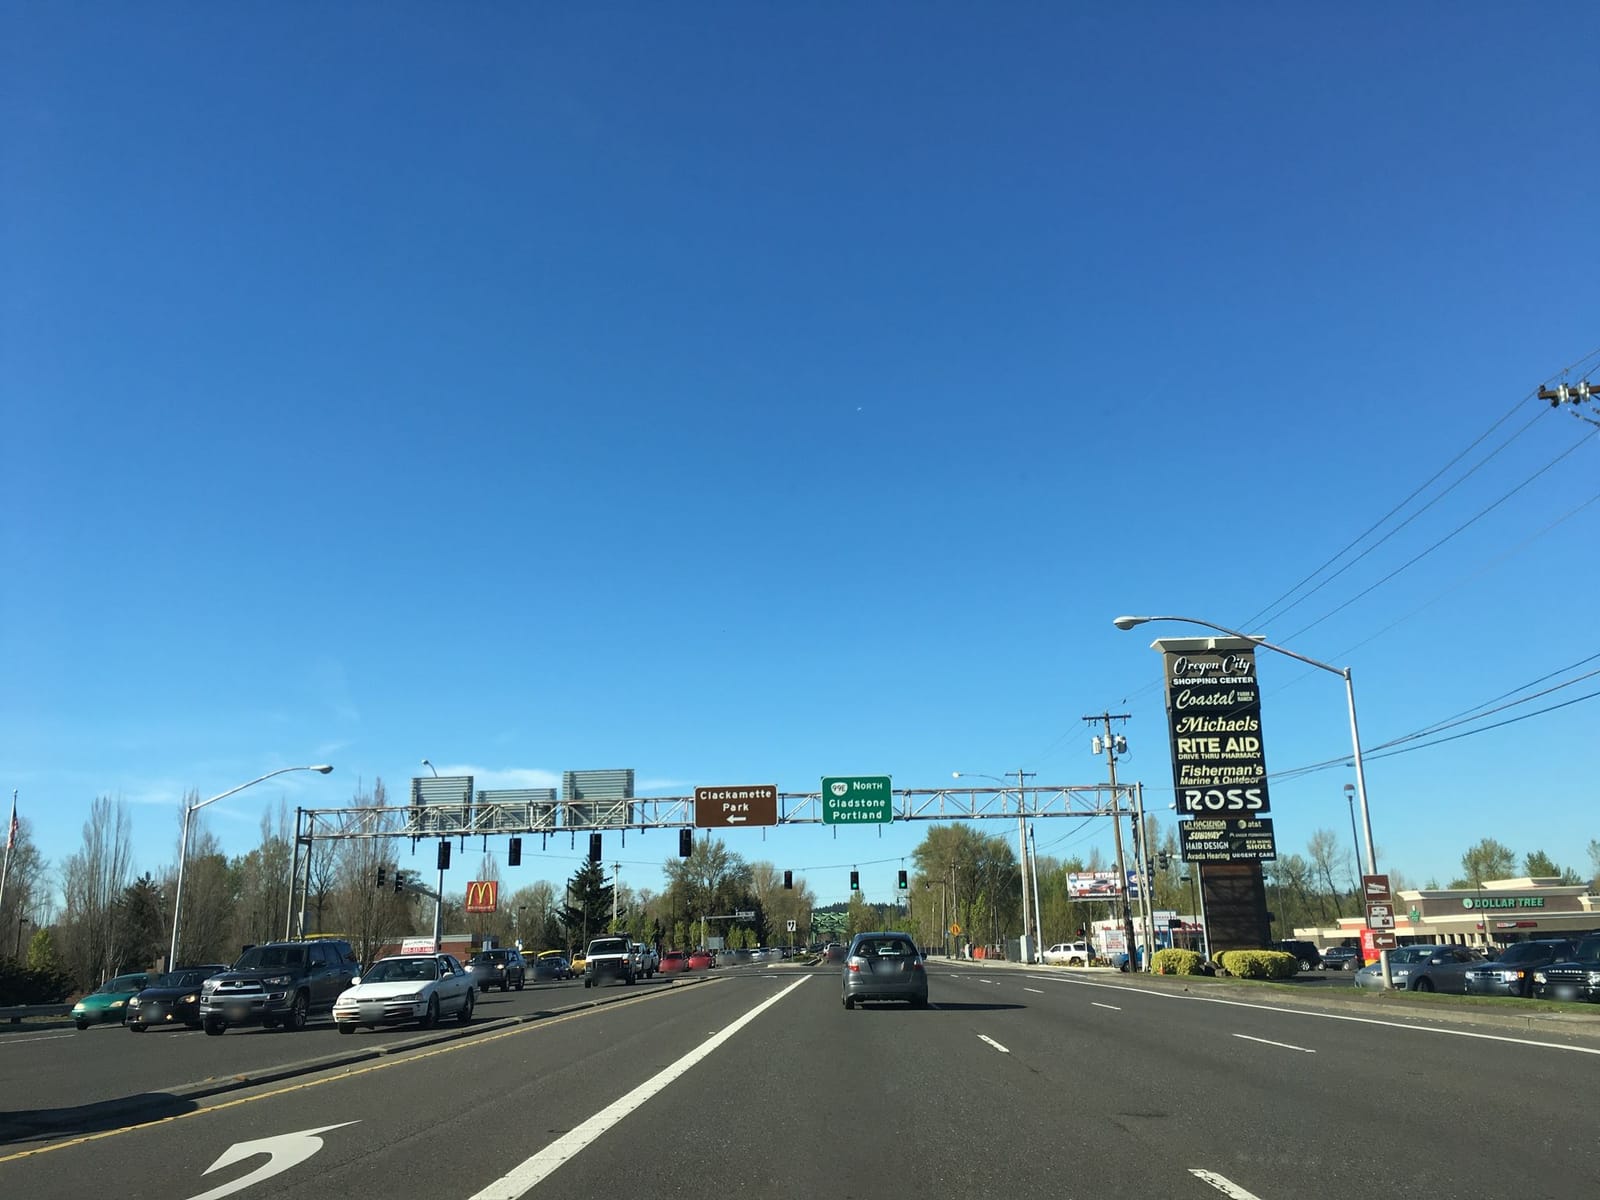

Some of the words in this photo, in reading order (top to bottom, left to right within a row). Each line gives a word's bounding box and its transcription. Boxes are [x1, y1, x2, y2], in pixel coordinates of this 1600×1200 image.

[1174, 656, 1219, 675] Oregon
[1222, 655, 1250, 674] City
[1173, 677, 1217, 685] SHOPPING
[1176, 689, 1235, 709] Coastal
[1176, 715, 1258, 733] Michaels
[1177, 737, 1221, 753] RITE
[1225, 737, 1260, 752] AID
[1181, 764, 1264, 777] Fisherman's
[1180, 776, 1211, 785] Marine
[1213, 777, 1220, 785] &
[1222, 776, 1260, 785] Outdoor
[700, 789, 772, 800] Clackamette
[829, 799, 885, 808] Gladstone
[1185, 789, 1263, 811] ROSS
[722, 802, 749, 812] Park
[833, 811, 882, 820] Portland
[1188, 831, 1224, 840] SUBWAY
[1185, 842, 1203, 850] HAIR
[1203, 841, 1229, 850] DESIGN
[1206, 852, 1230, 861] Hearing
[1474, 898, 1515, 908] DOLLAR
[1518, 897, 1544, 907] TREE
